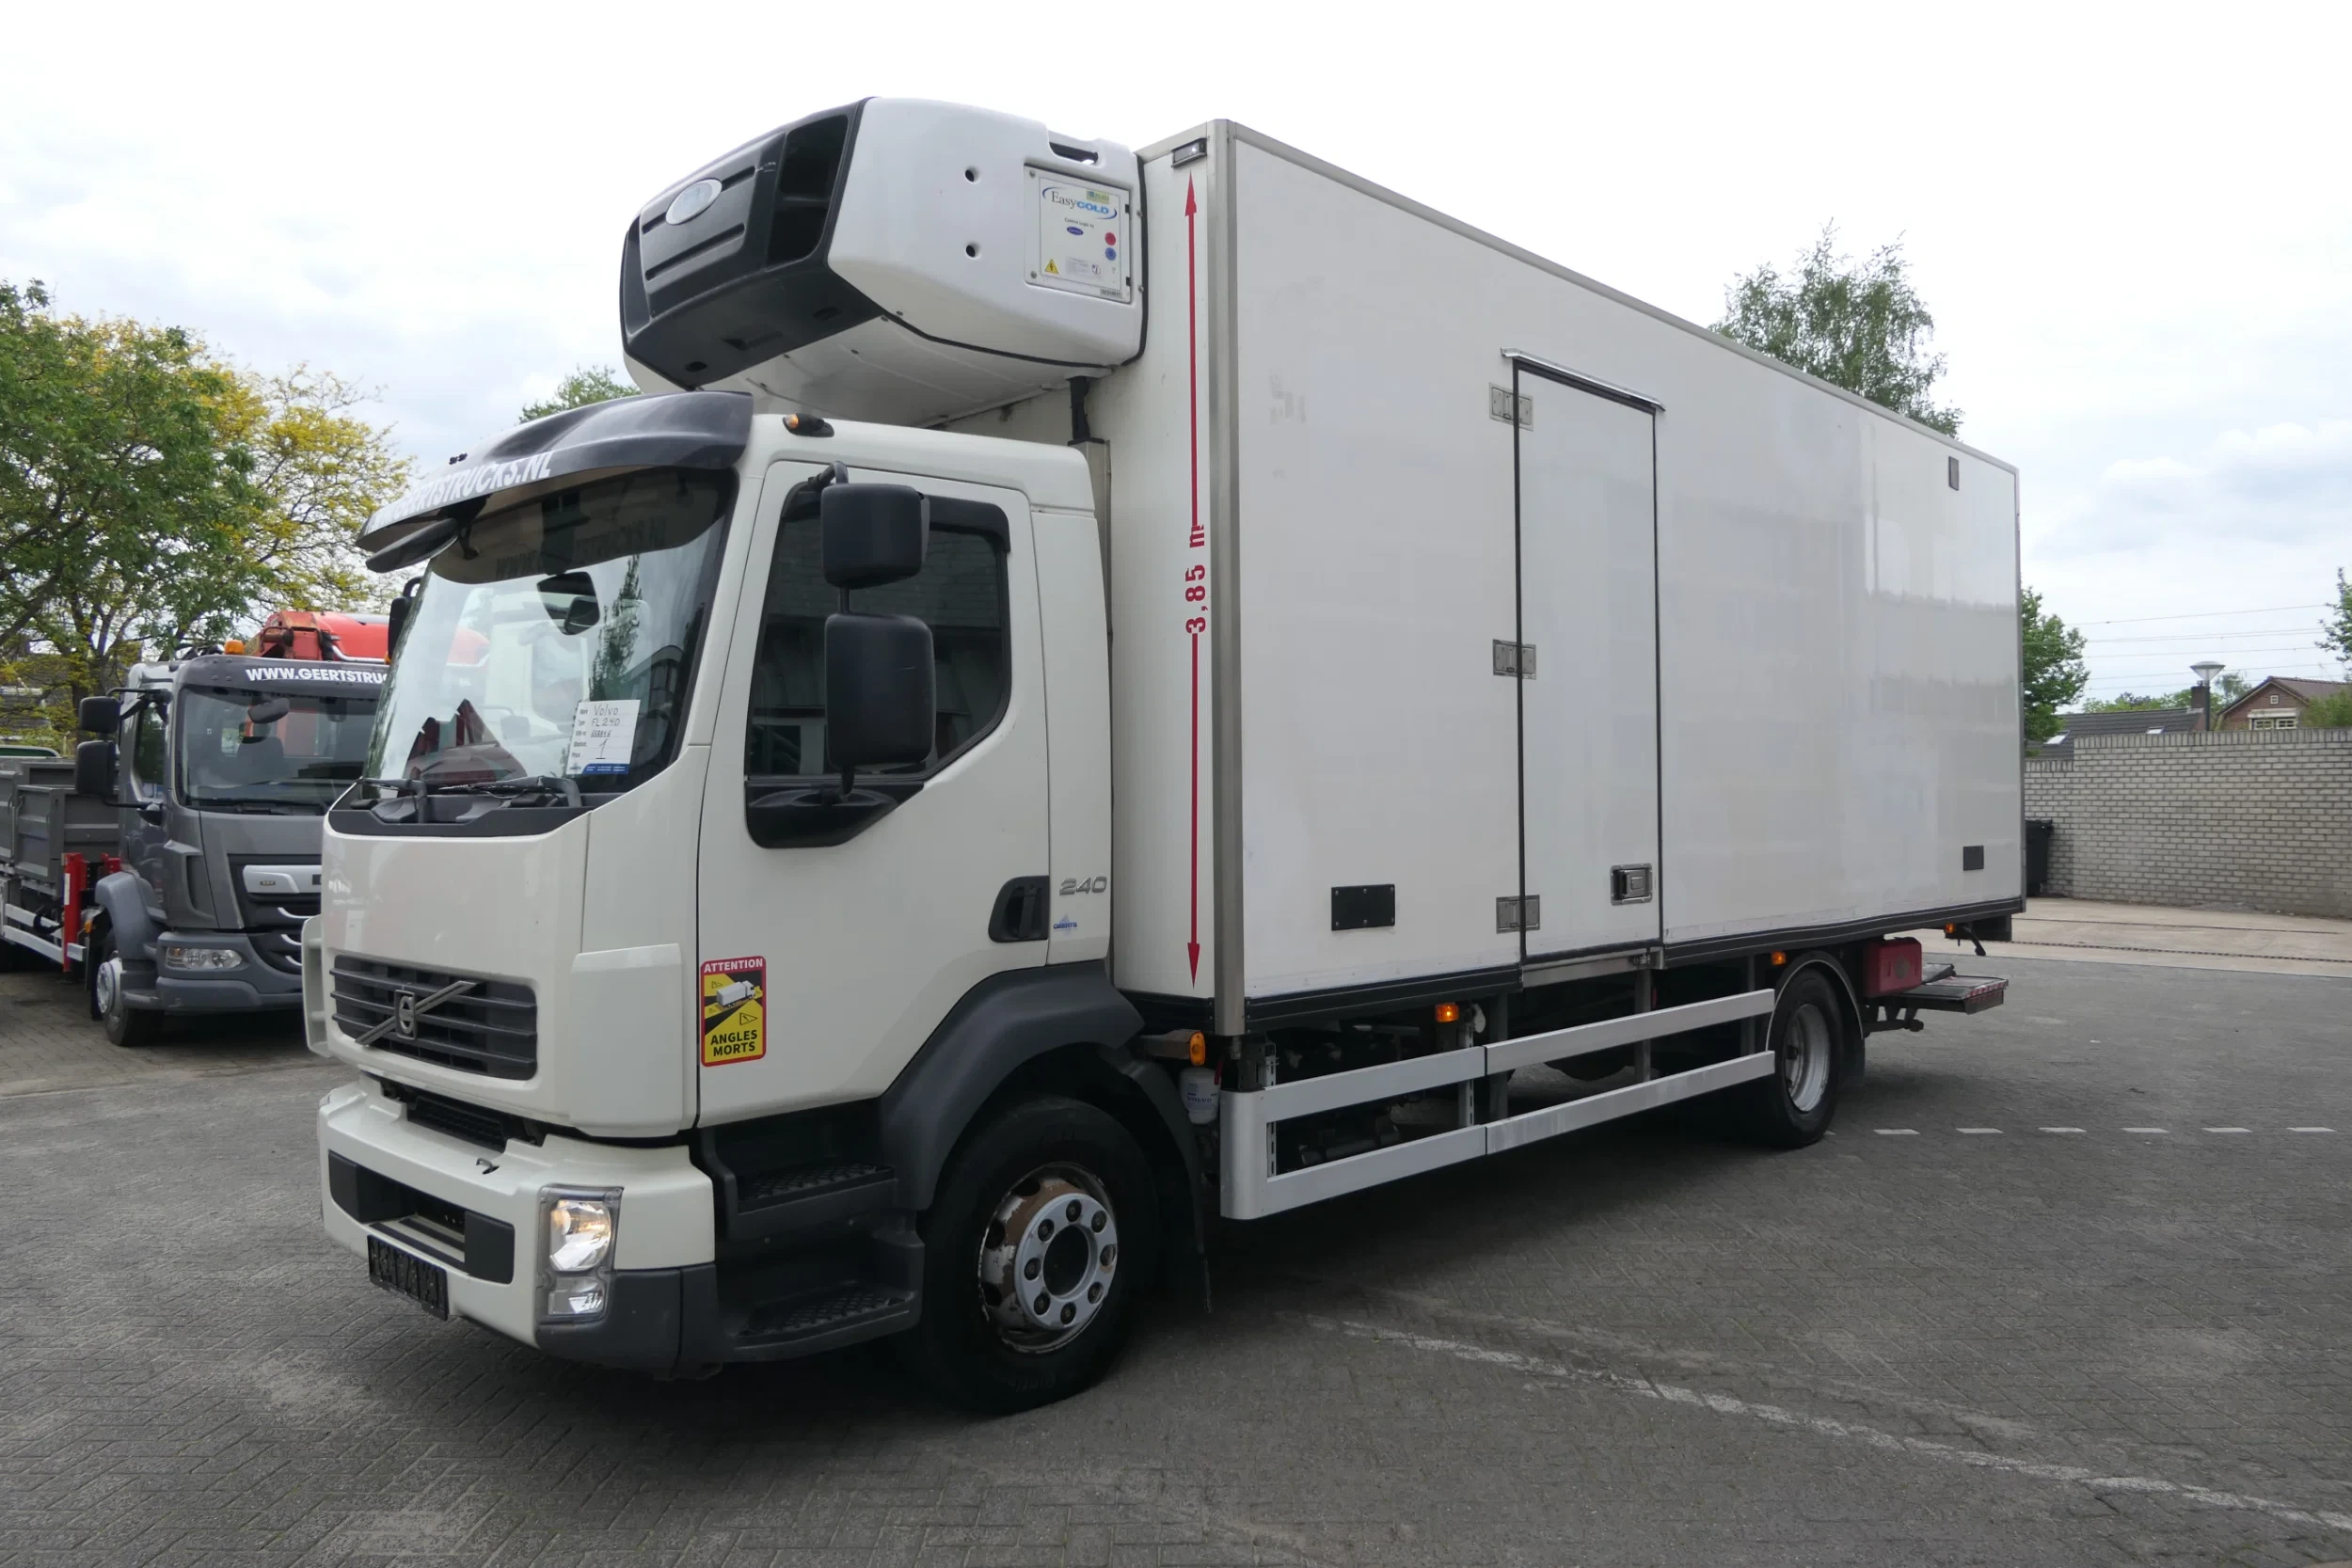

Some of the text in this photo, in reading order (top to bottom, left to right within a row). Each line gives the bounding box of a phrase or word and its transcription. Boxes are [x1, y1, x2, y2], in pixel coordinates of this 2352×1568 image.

[1184, 564, 1208, 634] 3,85
[594, 704, 619, 716] Volvo
[1059, 876, 1108, 895] 240
[704, 958, 763, 973] ATTENTION
[710, 1029, 758, 1046] ANGLES
[713, 1041, 756, 1057] MORTS
